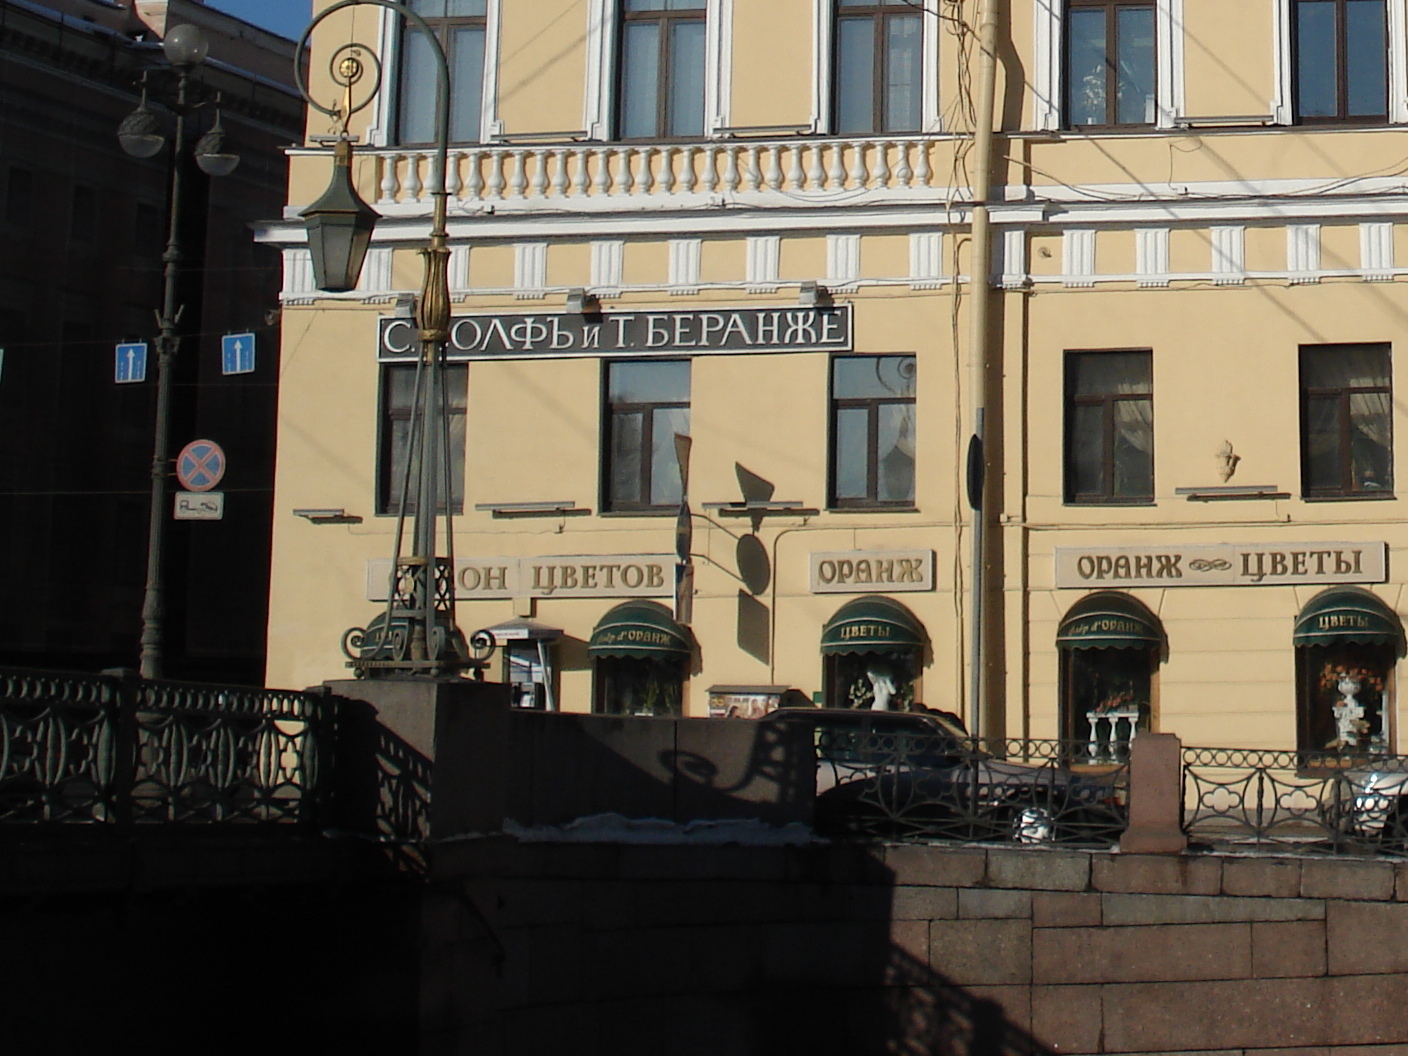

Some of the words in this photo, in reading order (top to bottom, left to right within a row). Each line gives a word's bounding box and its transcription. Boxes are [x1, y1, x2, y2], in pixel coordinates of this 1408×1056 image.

[384, 321, 416, 353] С.
[449, 317, 575, 350] ОЛФЪ
[582, 326, 600, 348] и
[608, 316, 635, 348] Т.
[646, 310, 845, 347] БЕРАНЖЕ
[532, 564, 664, 595] ЦВЕТОВ
[819, 559, 923, 584] ОРАНЖ
[1077, 555, 1183, 580] ОРАНЖ
[1240, 550, 1363, 582] ЦВЕТЫ
[840, 625, 890, 640] ЦВЕТЫ
[1319, 615, 1368, 631] ЦВЕТЫ
